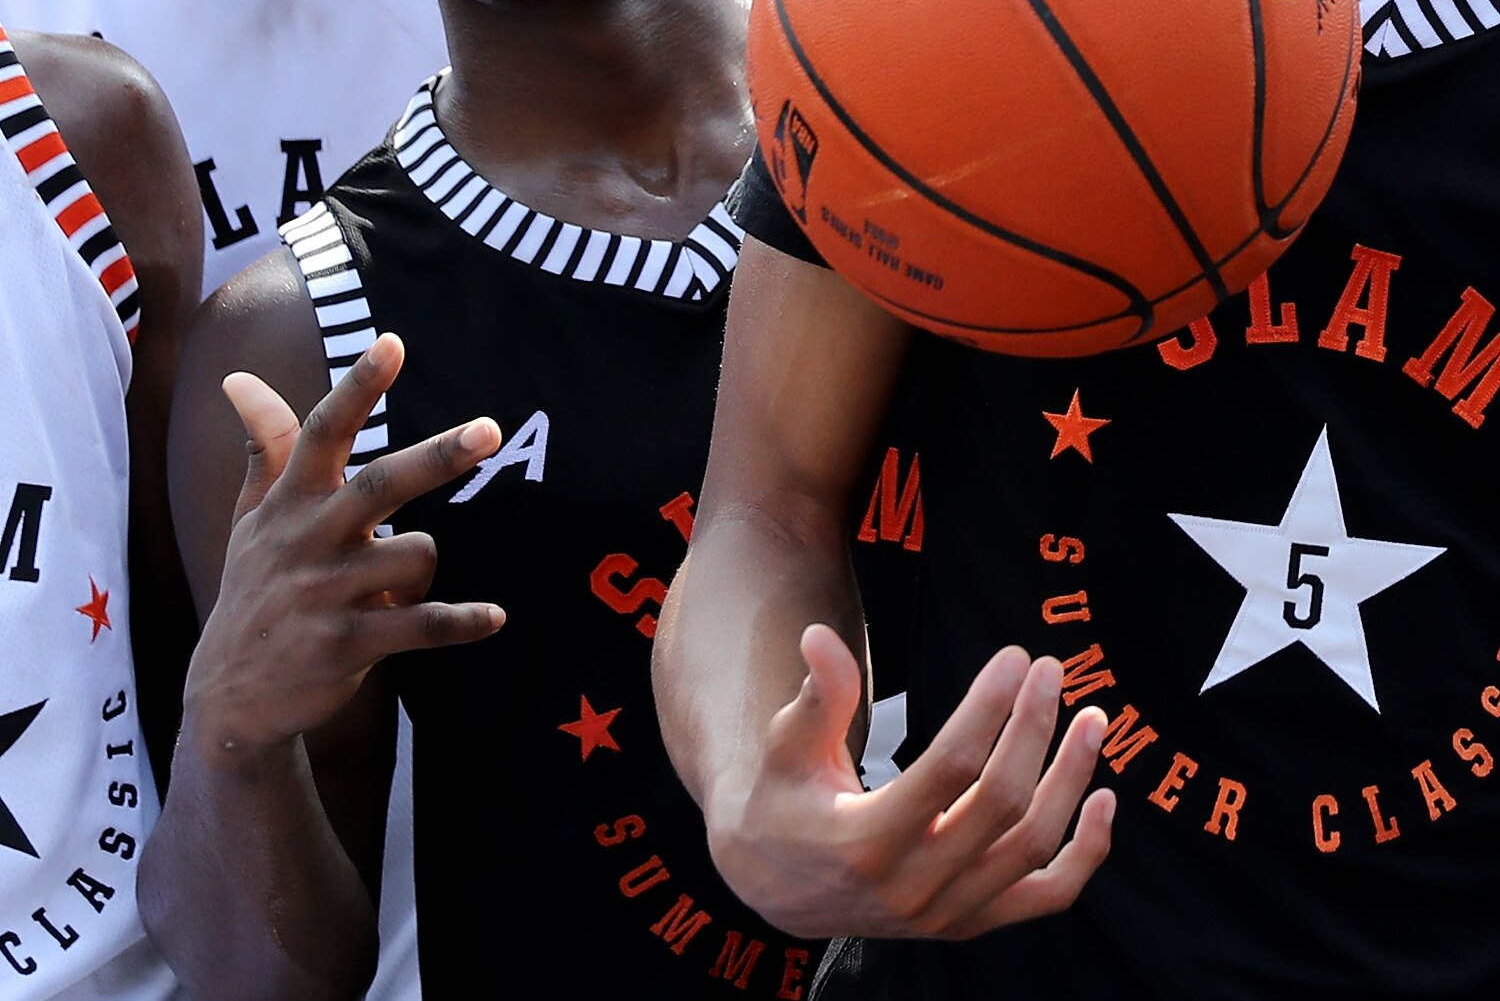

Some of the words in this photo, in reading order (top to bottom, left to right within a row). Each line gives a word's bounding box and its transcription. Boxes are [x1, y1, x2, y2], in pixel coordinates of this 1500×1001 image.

[194, 138, 324, 250] LA
[905, 262, 945, 291] GAME
[590, 447, 925, 639] SM
[1282, 542, 1330, 630] 5
[1040, 533, 1248, 841] SUMMER
[0, 689, 139, 976] CLASSIC
[593, 814, 809, 1001] SUMME
